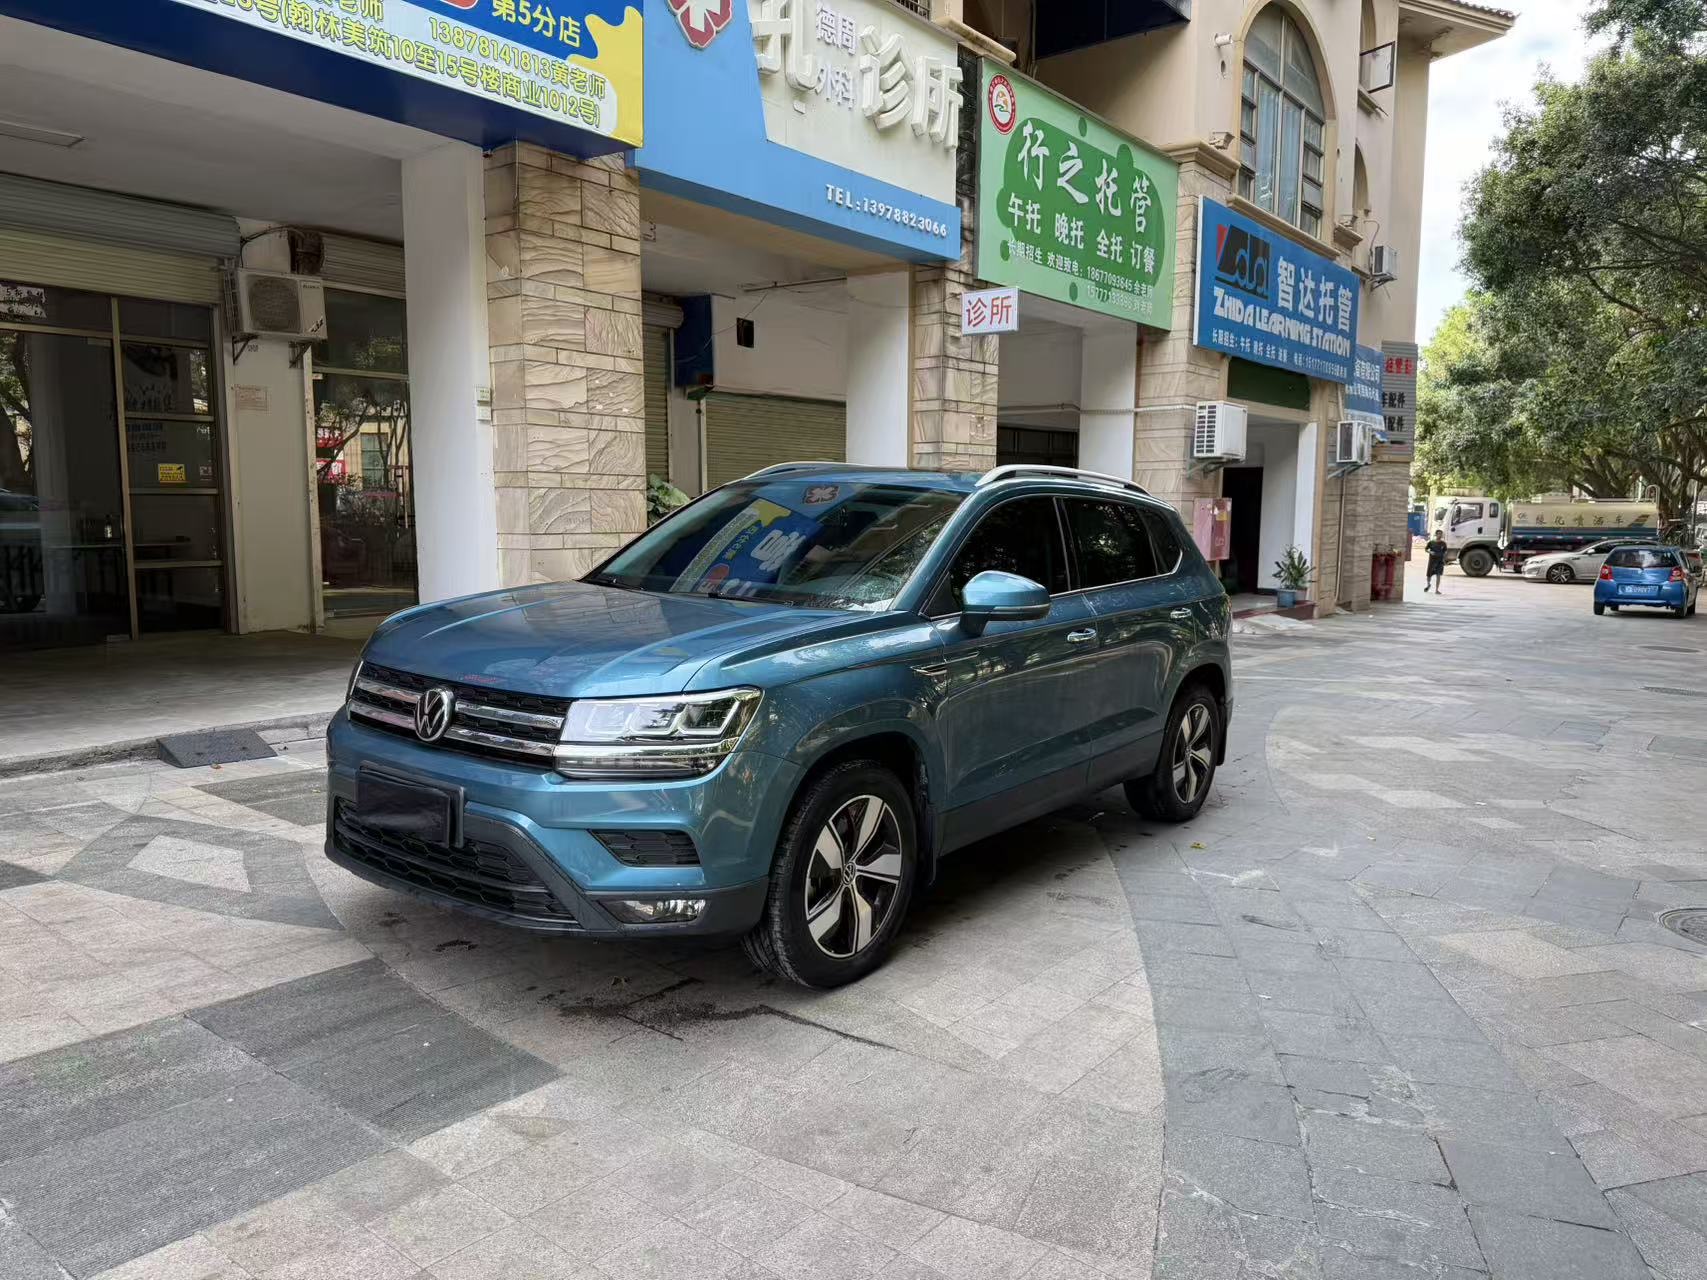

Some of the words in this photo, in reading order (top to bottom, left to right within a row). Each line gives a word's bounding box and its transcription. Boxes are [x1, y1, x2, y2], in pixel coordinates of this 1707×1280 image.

[492, 0, 581, 48] 第5分店
[814, 63, 855, 112] 外科
[860, 25, 963, 152] 诊所
[1017, 119, 1153, 234] 行之托管
[1007, 192, 1041, 235] 午托
[1055, 212, 1085, 250] 晚托
[1095, 228, 1124, 264] 全托
[1129, 240, 1156, 275] 订餐
[965, 295, 1012, 329] 诊所
[1213, 287, 1254, 327] ZHIDA
[1313, 324, 1351, 358] STATION
[1277, 256, 1353, 334] 智达托管
